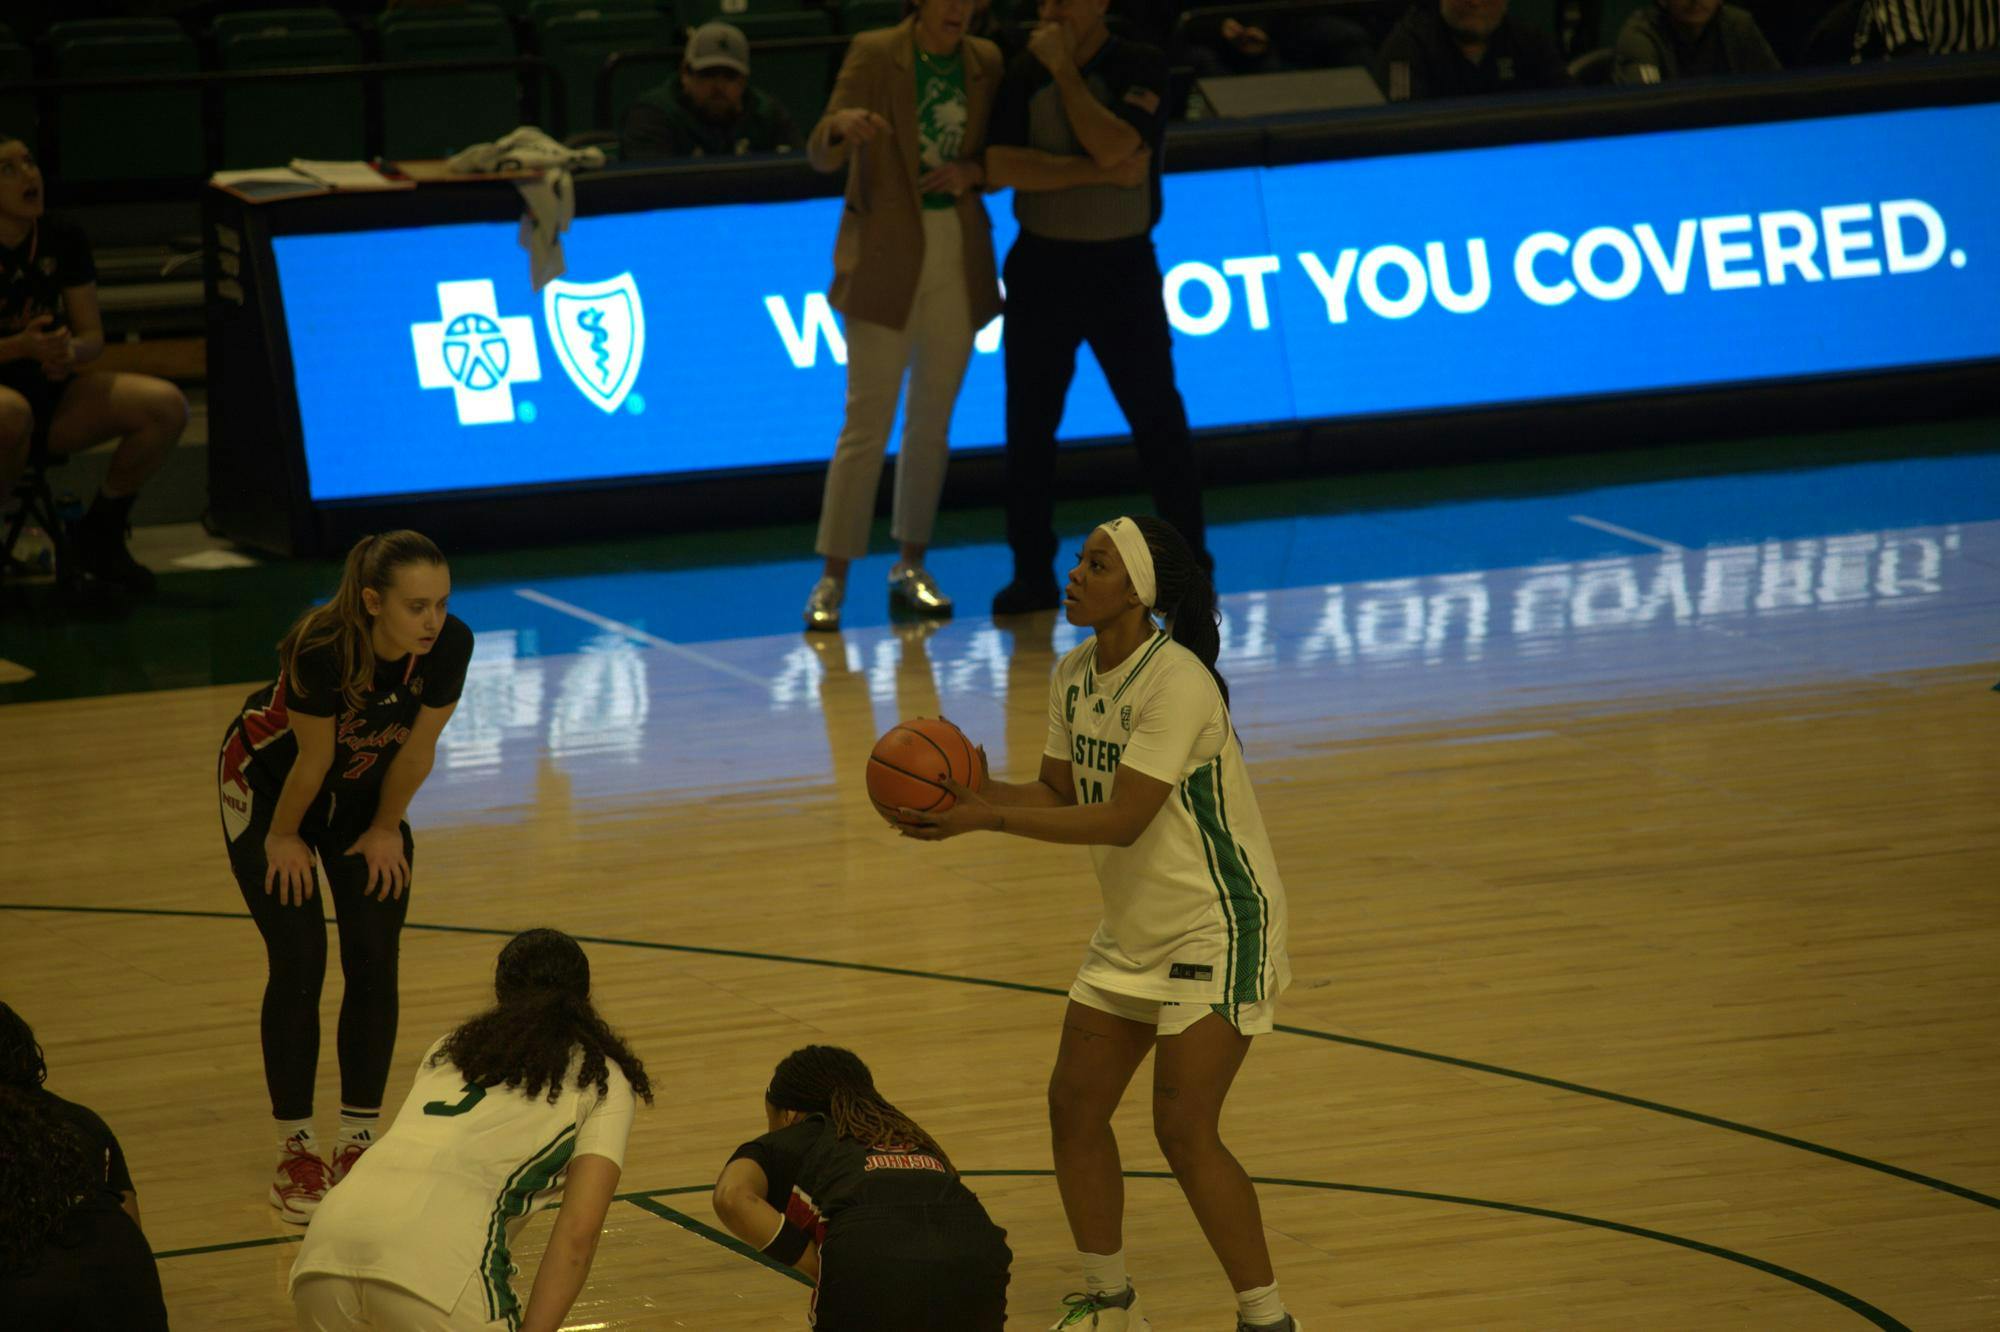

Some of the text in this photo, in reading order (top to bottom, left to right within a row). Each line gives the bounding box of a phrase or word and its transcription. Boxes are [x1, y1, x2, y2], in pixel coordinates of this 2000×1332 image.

[1162, 198, 1967, 335] OT YOU COVERED.
[342, 751, 380, 779] 7
[1070, 730, 1127, 773] STER
[223, 791, 248, 813] NIU
[864, 1154, 946, 1173] JOHNSON
